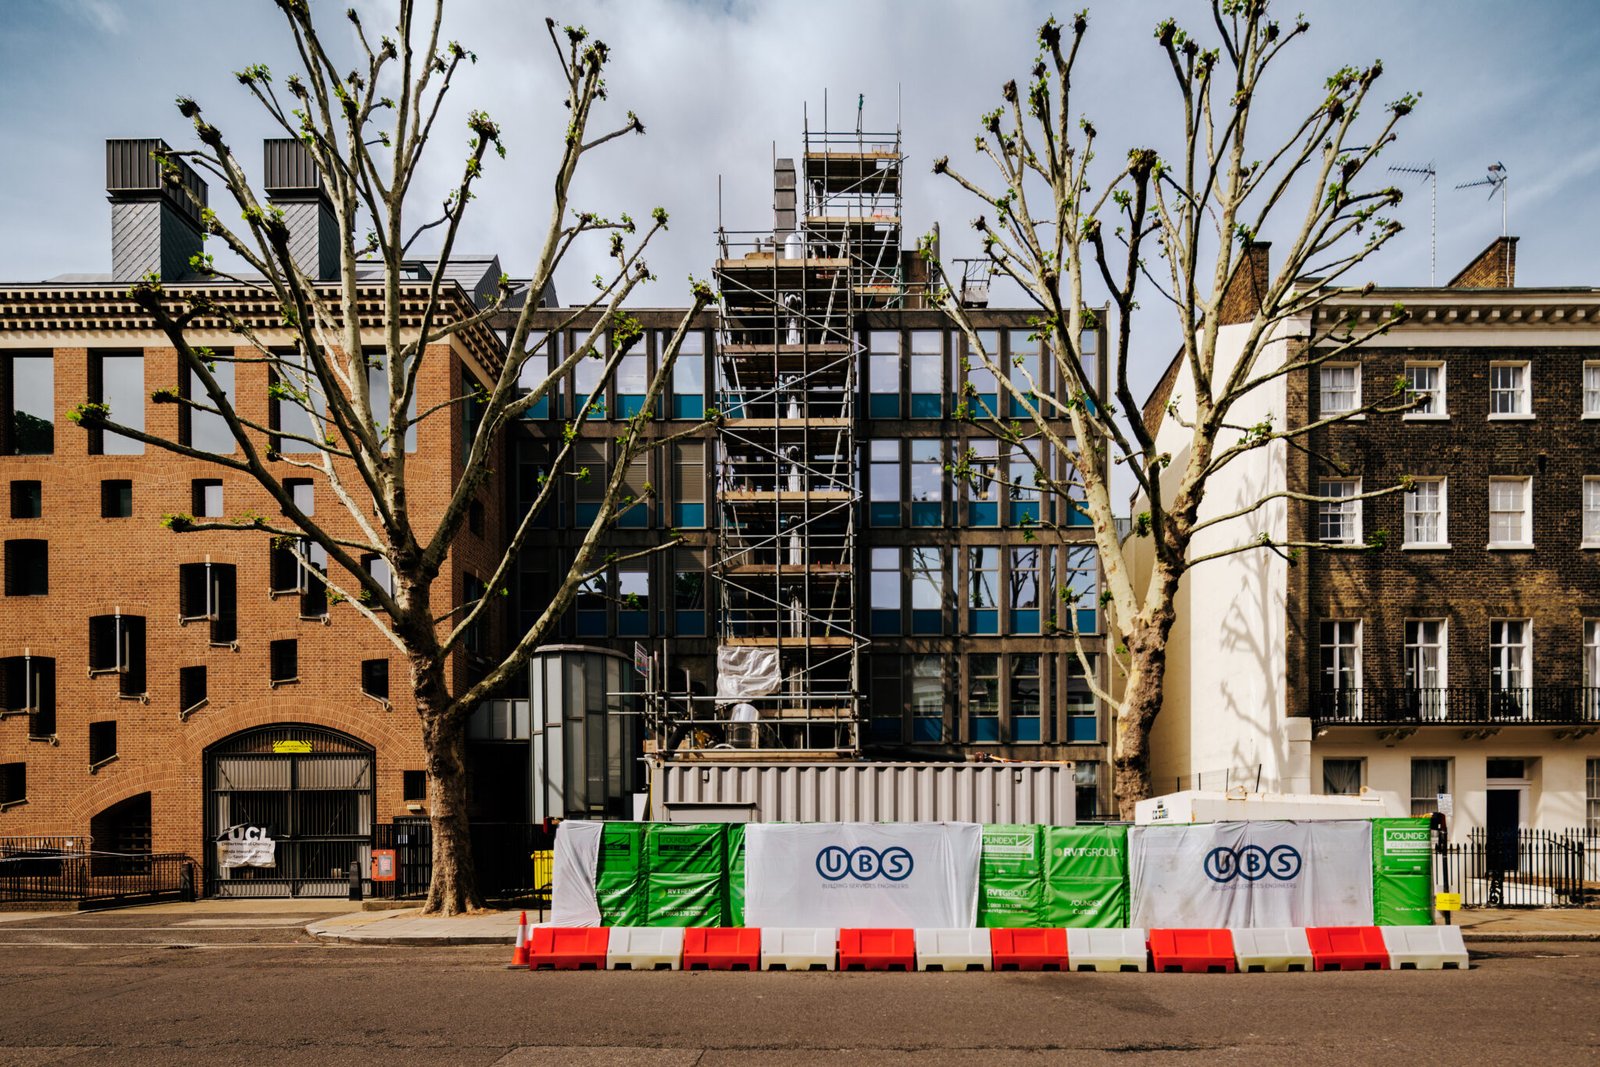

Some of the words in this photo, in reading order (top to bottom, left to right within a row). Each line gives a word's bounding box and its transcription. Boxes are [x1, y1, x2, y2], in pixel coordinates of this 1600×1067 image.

[228, 826, 271, 840] UCL
[816, 846, 914, 881] UBS
[1204, 845, 1302, 883] UBS
